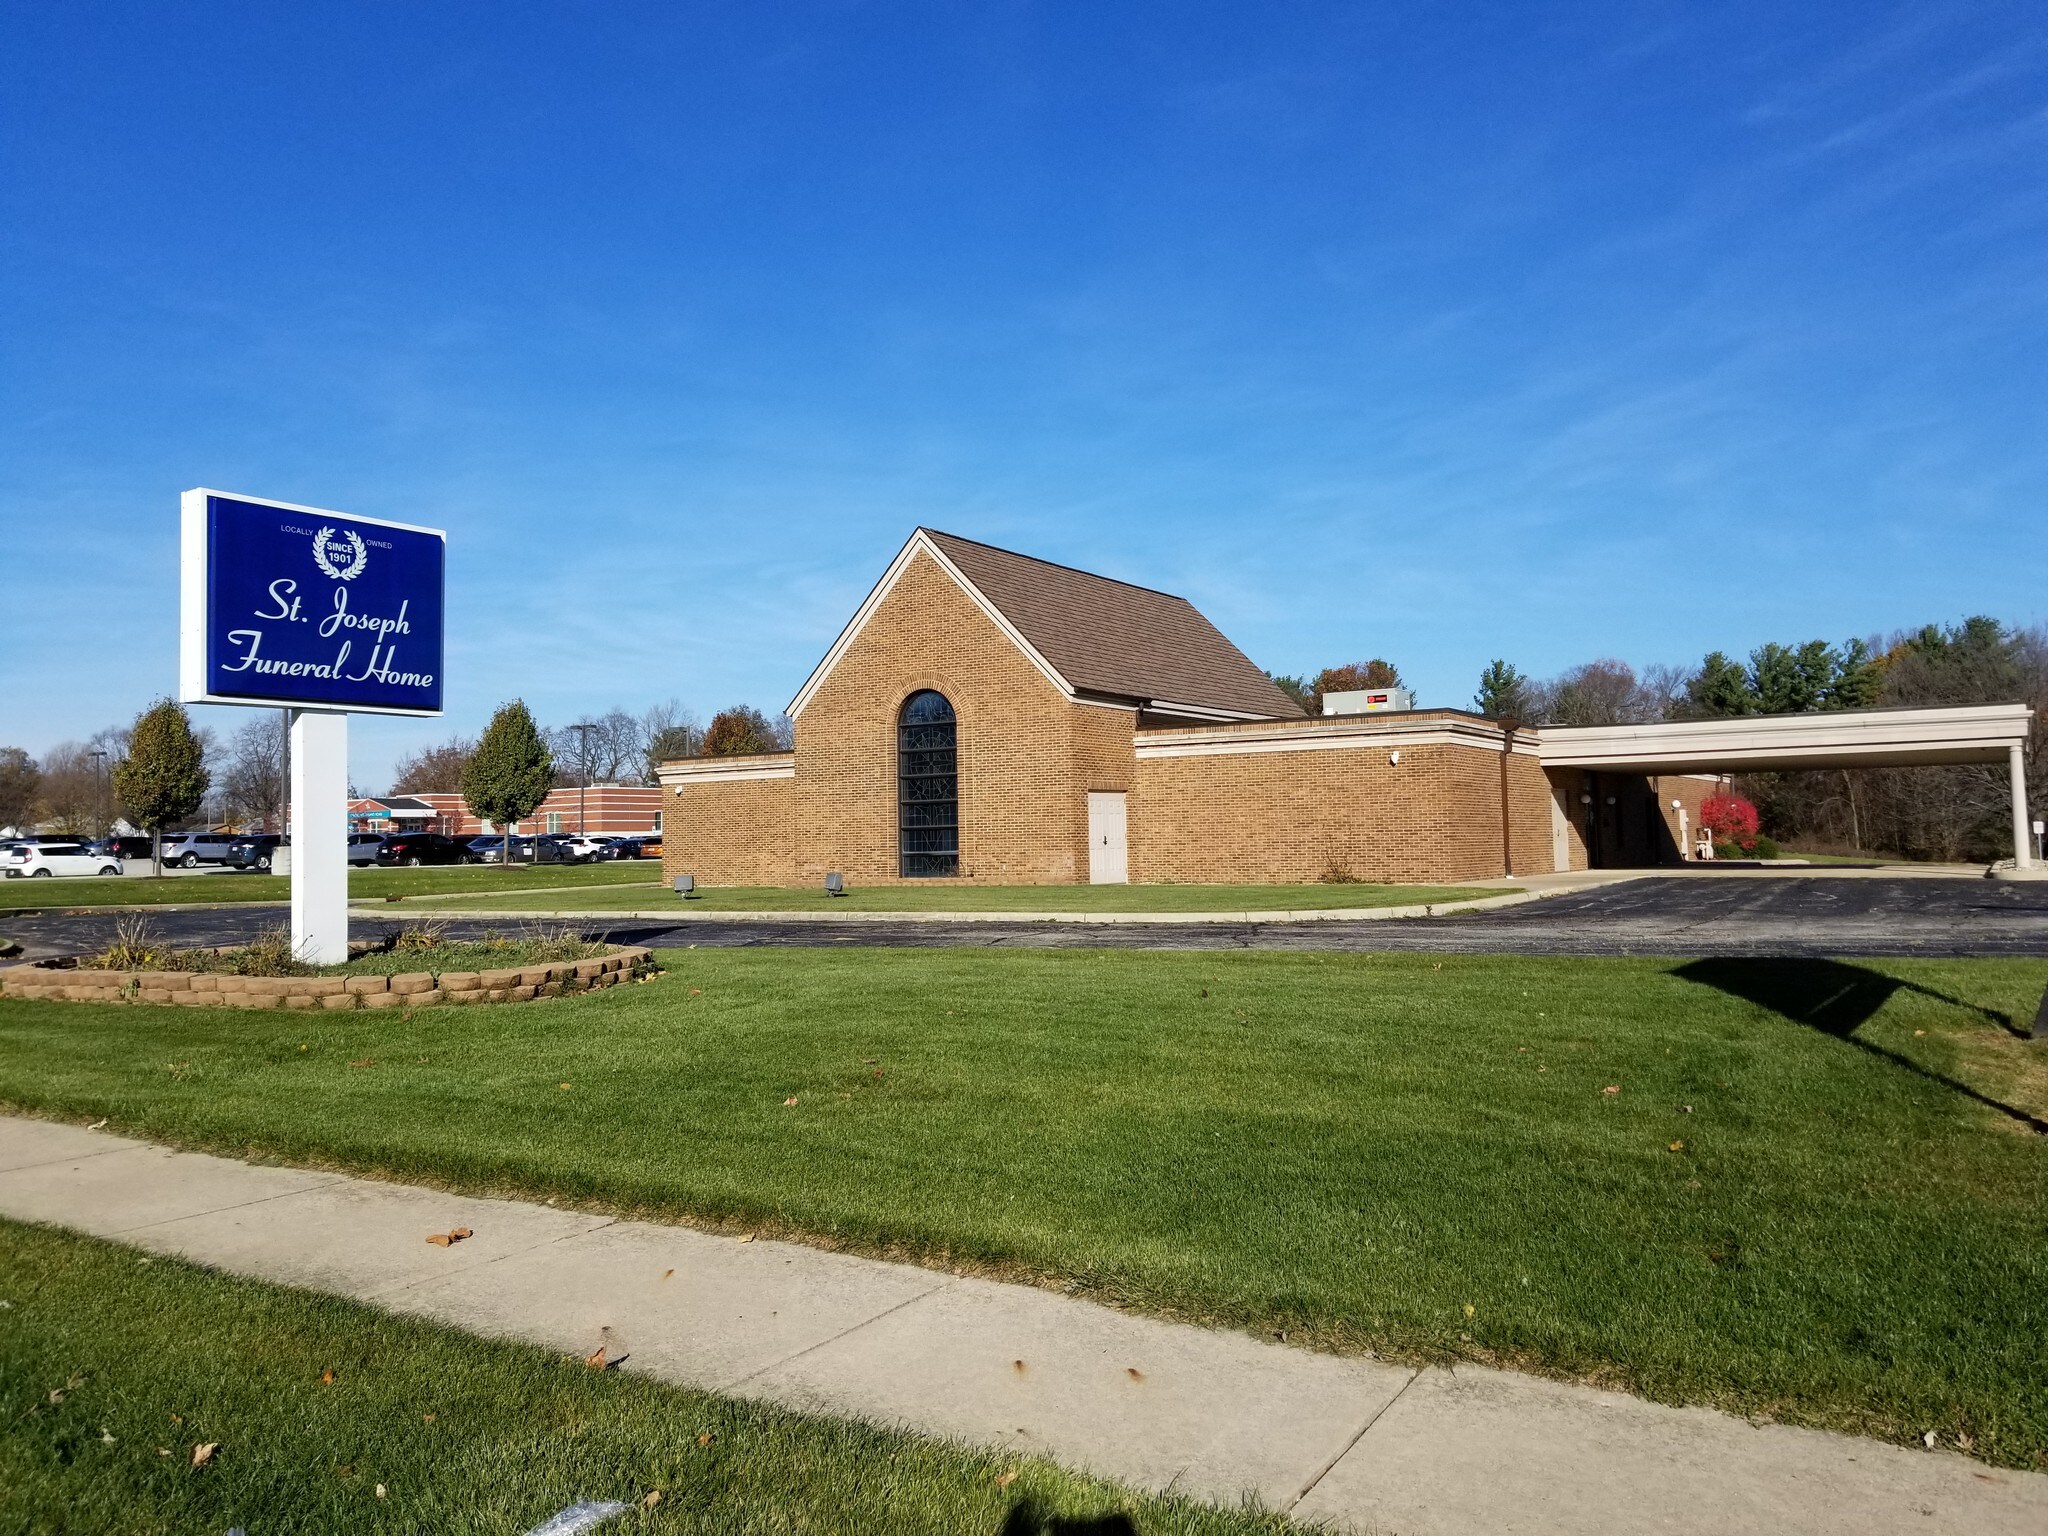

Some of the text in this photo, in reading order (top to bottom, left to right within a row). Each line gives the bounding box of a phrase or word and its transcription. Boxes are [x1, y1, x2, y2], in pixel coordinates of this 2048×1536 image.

[280, 524, 314, 536] LOCALLY
[326, 541, 353, 554] SINCE
[366, 539, 393, 549] OWNED
[329, 552, 351, 564] 1901
[253, 578, 411, 643] St. Joseph
[221, 629, 434, 688] Funeral Home
